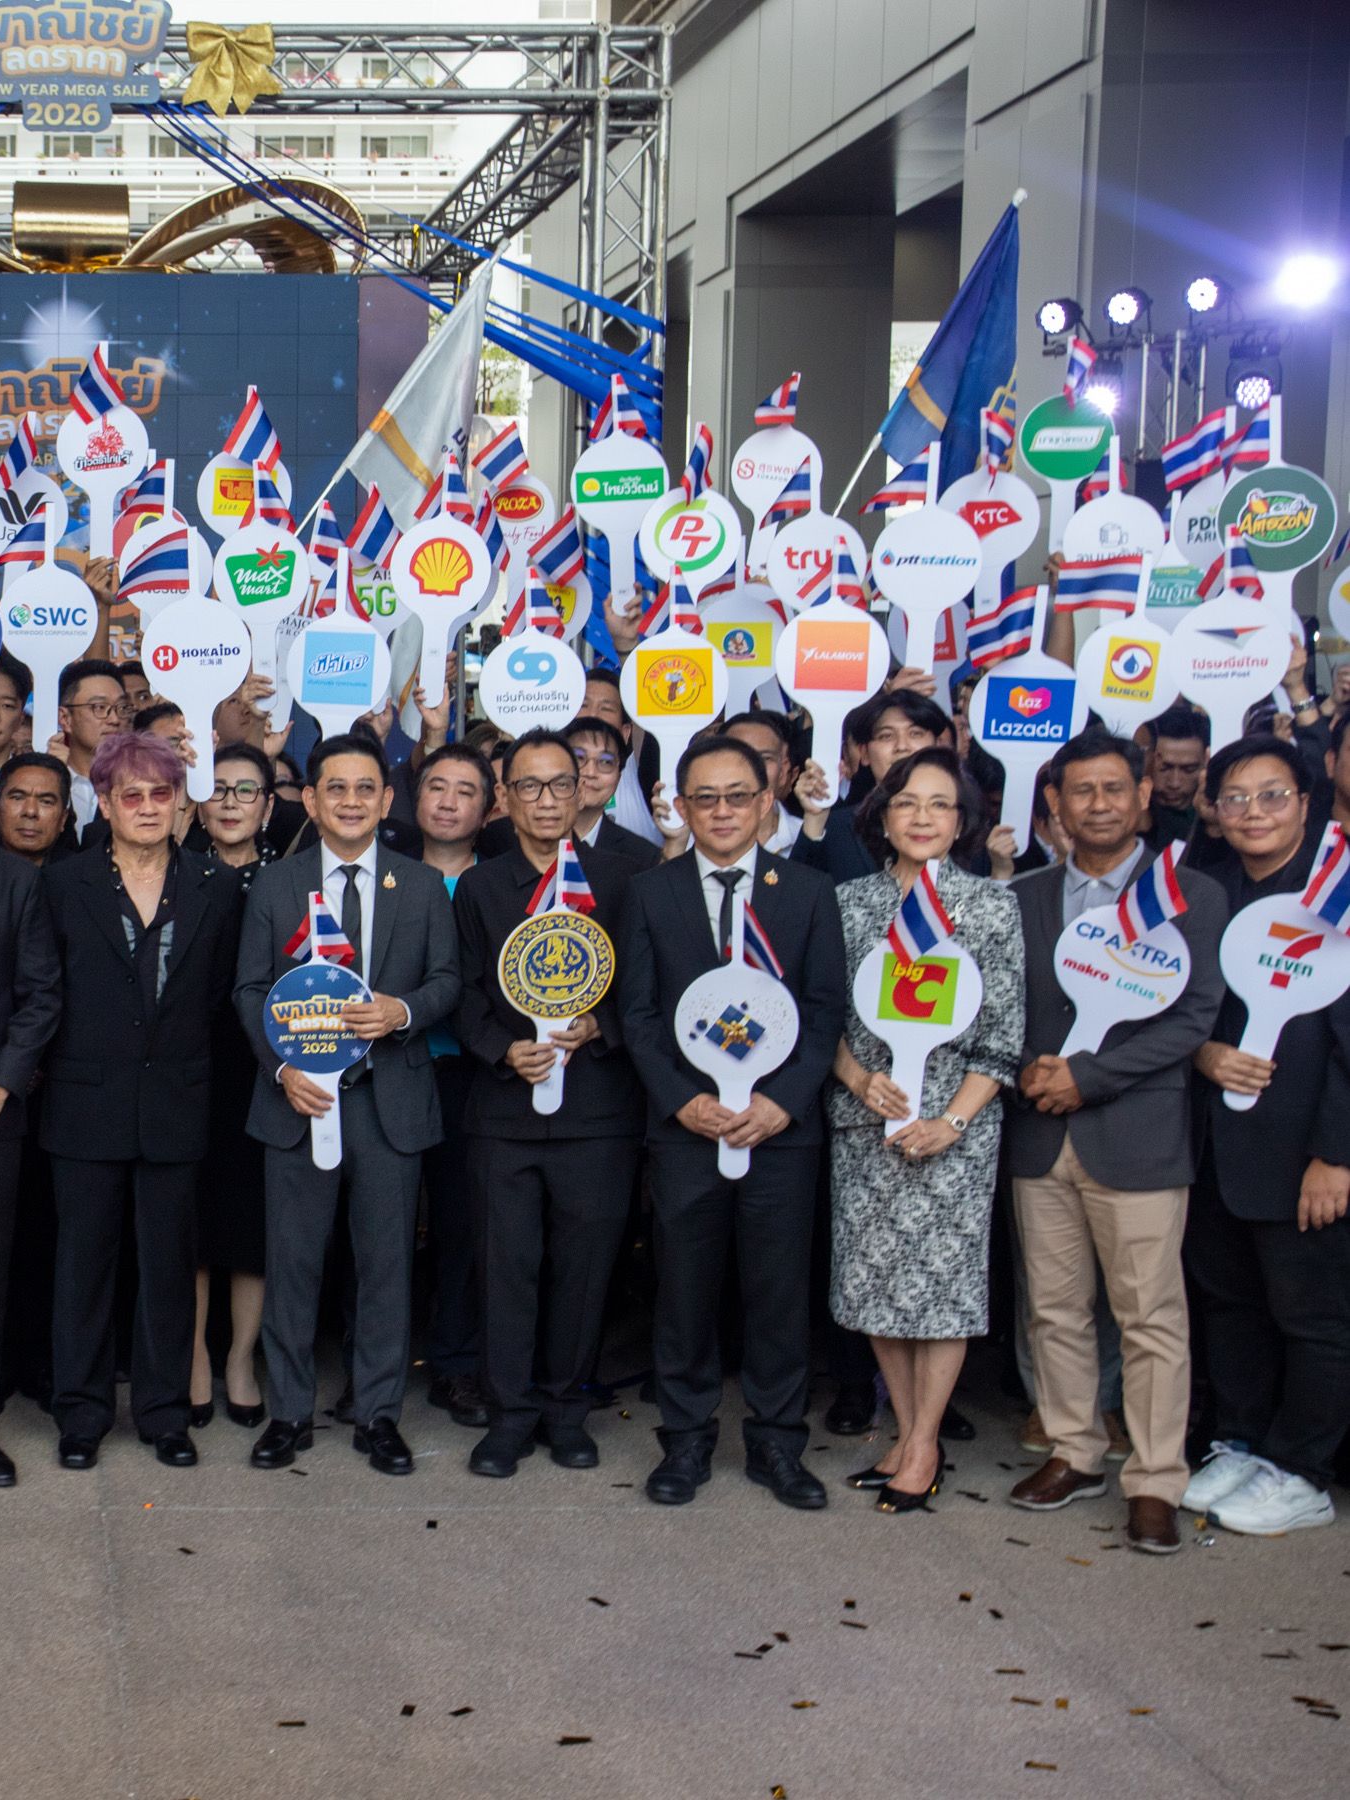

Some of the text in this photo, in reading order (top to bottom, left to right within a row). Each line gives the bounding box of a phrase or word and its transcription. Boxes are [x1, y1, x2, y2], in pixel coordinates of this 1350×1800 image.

[5, 45, 125, 77] ลดราคา
[19, 83, 59, 96] YEAR
[64, 84, 107, 97] MEGA
[112, 84, 149, 97] SALE
[26, 102, 101, 127] 2026
[973, 507, 1009, 525] KTC
[784, 547, 834, 570] tru
[233, 564, 289, 585] max
[239, 579, 284, 596] mart
[356, 582, 397, 617] 5G
[33, 606, 87, 627] SWC
[814, 651, 864, 662] LALAMOVE
[1106, 686, 1149, 698] SUSCO
[497, 703, 570, 714] TOP CHAROEN
[990, 718, 1063, 739] Lazada
[1075, 921, 1105, 940] CP
[892, 961, 925, 983] big
[1062, 957, 1167, 1005] makro Lotus's
[279, 1034, 296, 1042] NEW
[301, 1041, 337, 1054] 2026
